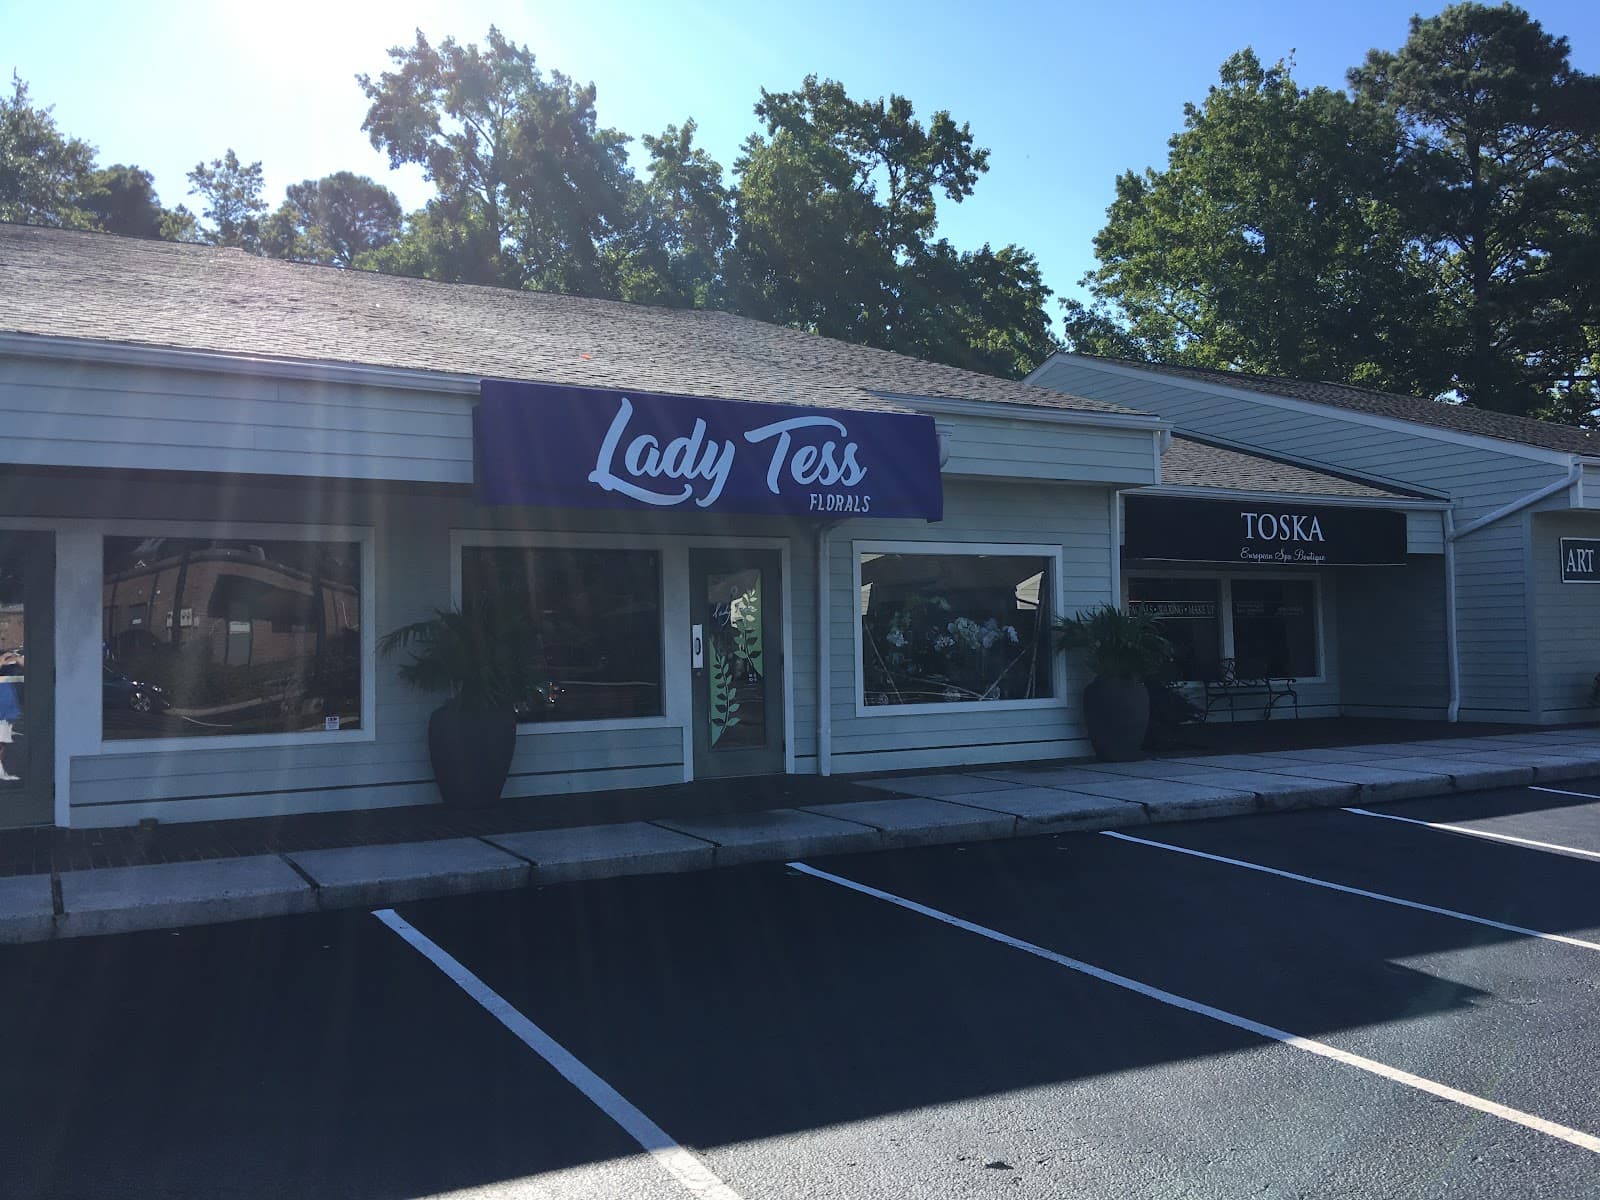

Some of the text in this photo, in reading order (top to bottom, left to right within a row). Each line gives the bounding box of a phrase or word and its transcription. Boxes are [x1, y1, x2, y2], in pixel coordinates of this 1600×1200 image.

[588, 397, 868, 508] Lady Tess
[809, 494, 871, 512] FLORALS
[1240, 512, 1325, 541] TOSKA
[1240, 547, 1326, 565] European Spa Boutique
[1566, 548, 1594, 572] ART
